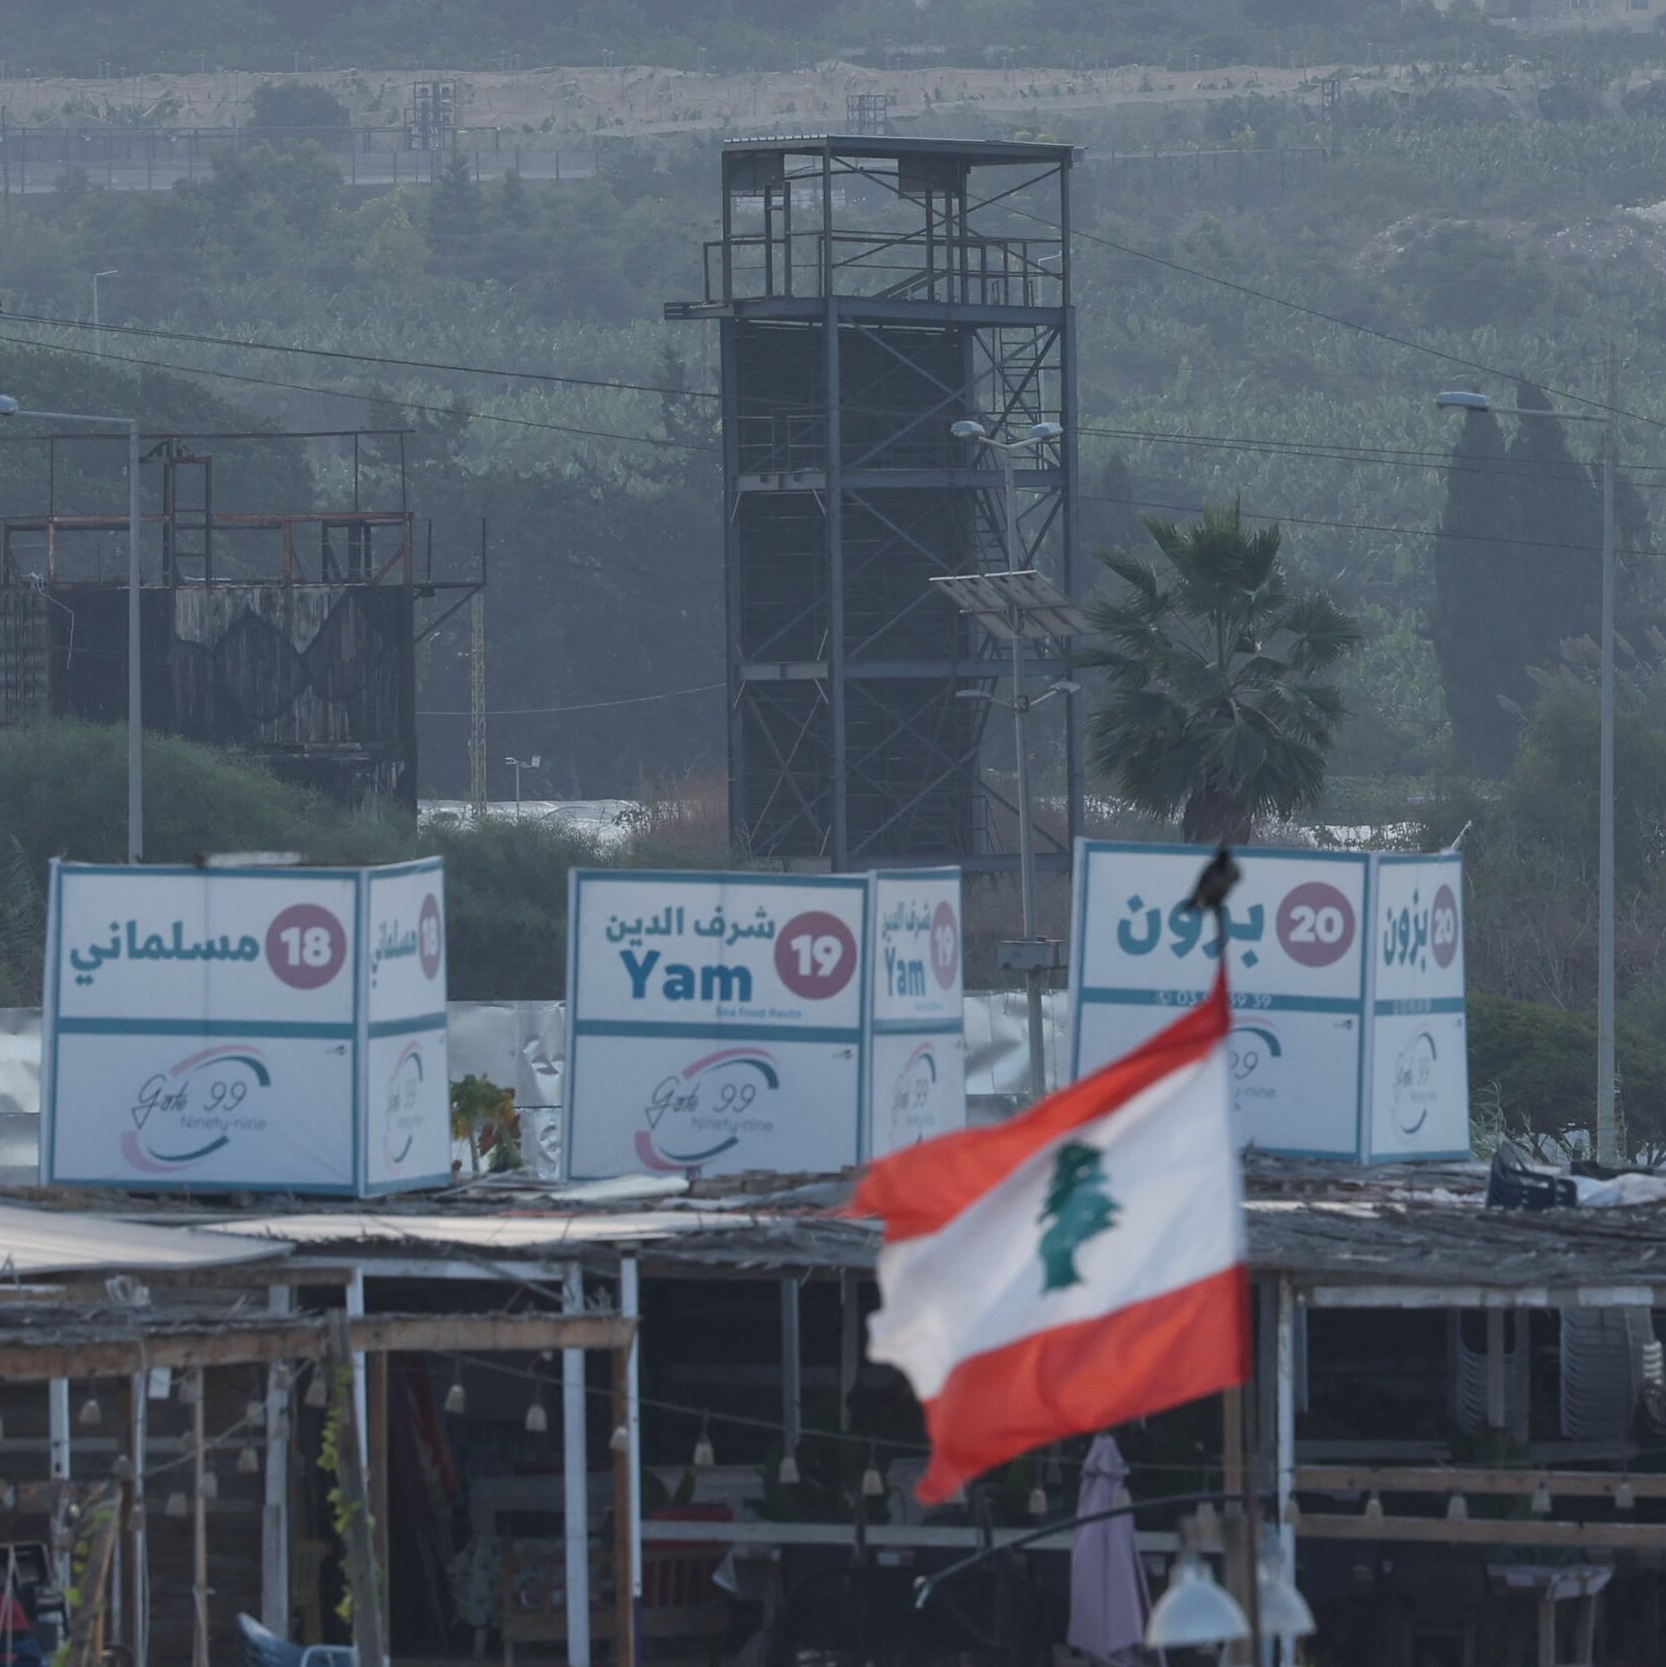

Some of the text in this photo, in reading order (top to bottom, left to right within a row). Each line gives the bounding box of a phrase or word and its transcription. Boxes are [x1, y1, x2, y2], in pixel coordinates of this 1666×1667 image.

[605, 906, 775, 947] شرف الدين
[1289, 905, 1344, 943] 20
[1434, 908, 1455, 944] 20
[70, 920, 259, 986] مسلماني
[280, 926, 333, 967] 18
[790, 934, 843, 977] 19
[935, 925, 955, 966] 19
[620, 949, 752, 1002] Yam
[885, 946, 926, 997] Yam
[203, 1081, 247, 1111] 99
[713, 1083, 756, 1113] 99
[181, 1116, 266, 1132] Ninety-nine
[691, 1117, 774, 1133] Ninety-nine
